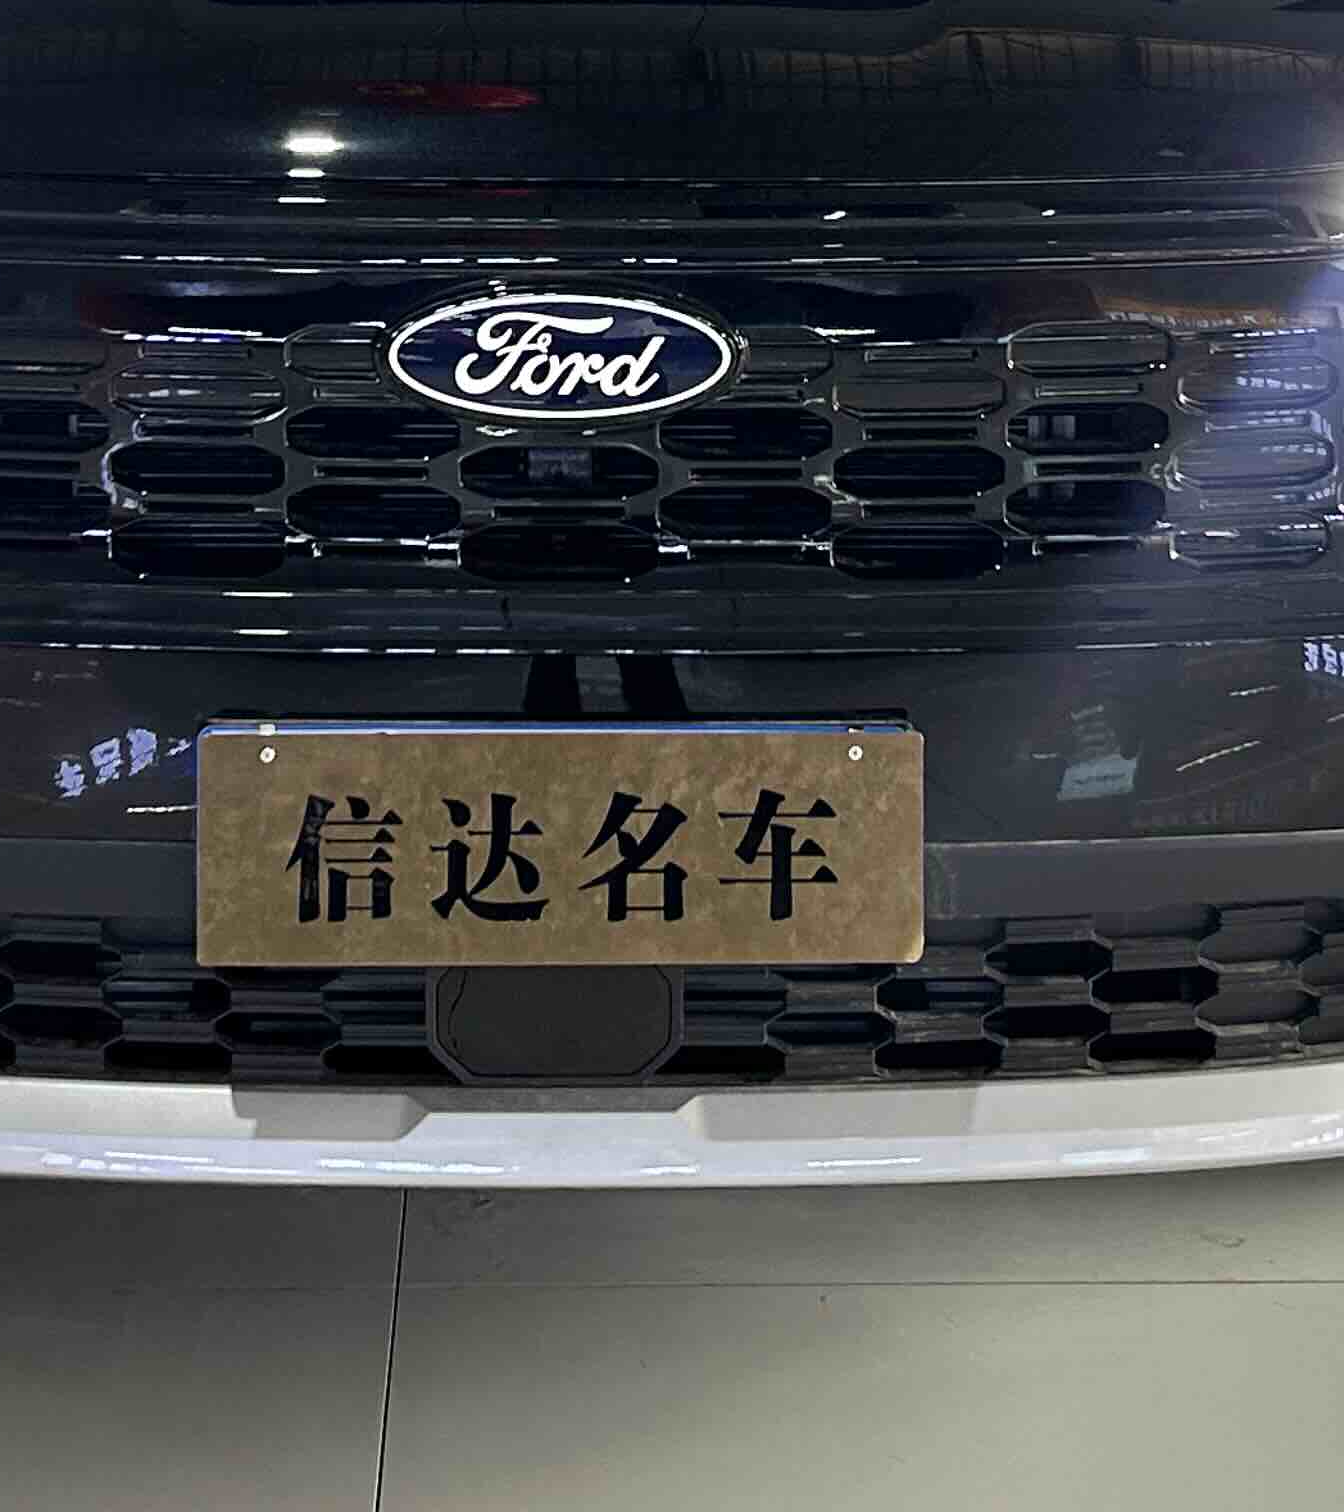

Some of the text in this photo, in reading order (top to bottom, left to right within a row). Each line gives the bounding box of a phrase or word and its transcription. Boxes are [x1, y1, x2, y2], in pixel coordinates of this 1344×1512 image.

[454, 311, 666, 397] Ford
[284, 787, 840, 924] 信达名车
